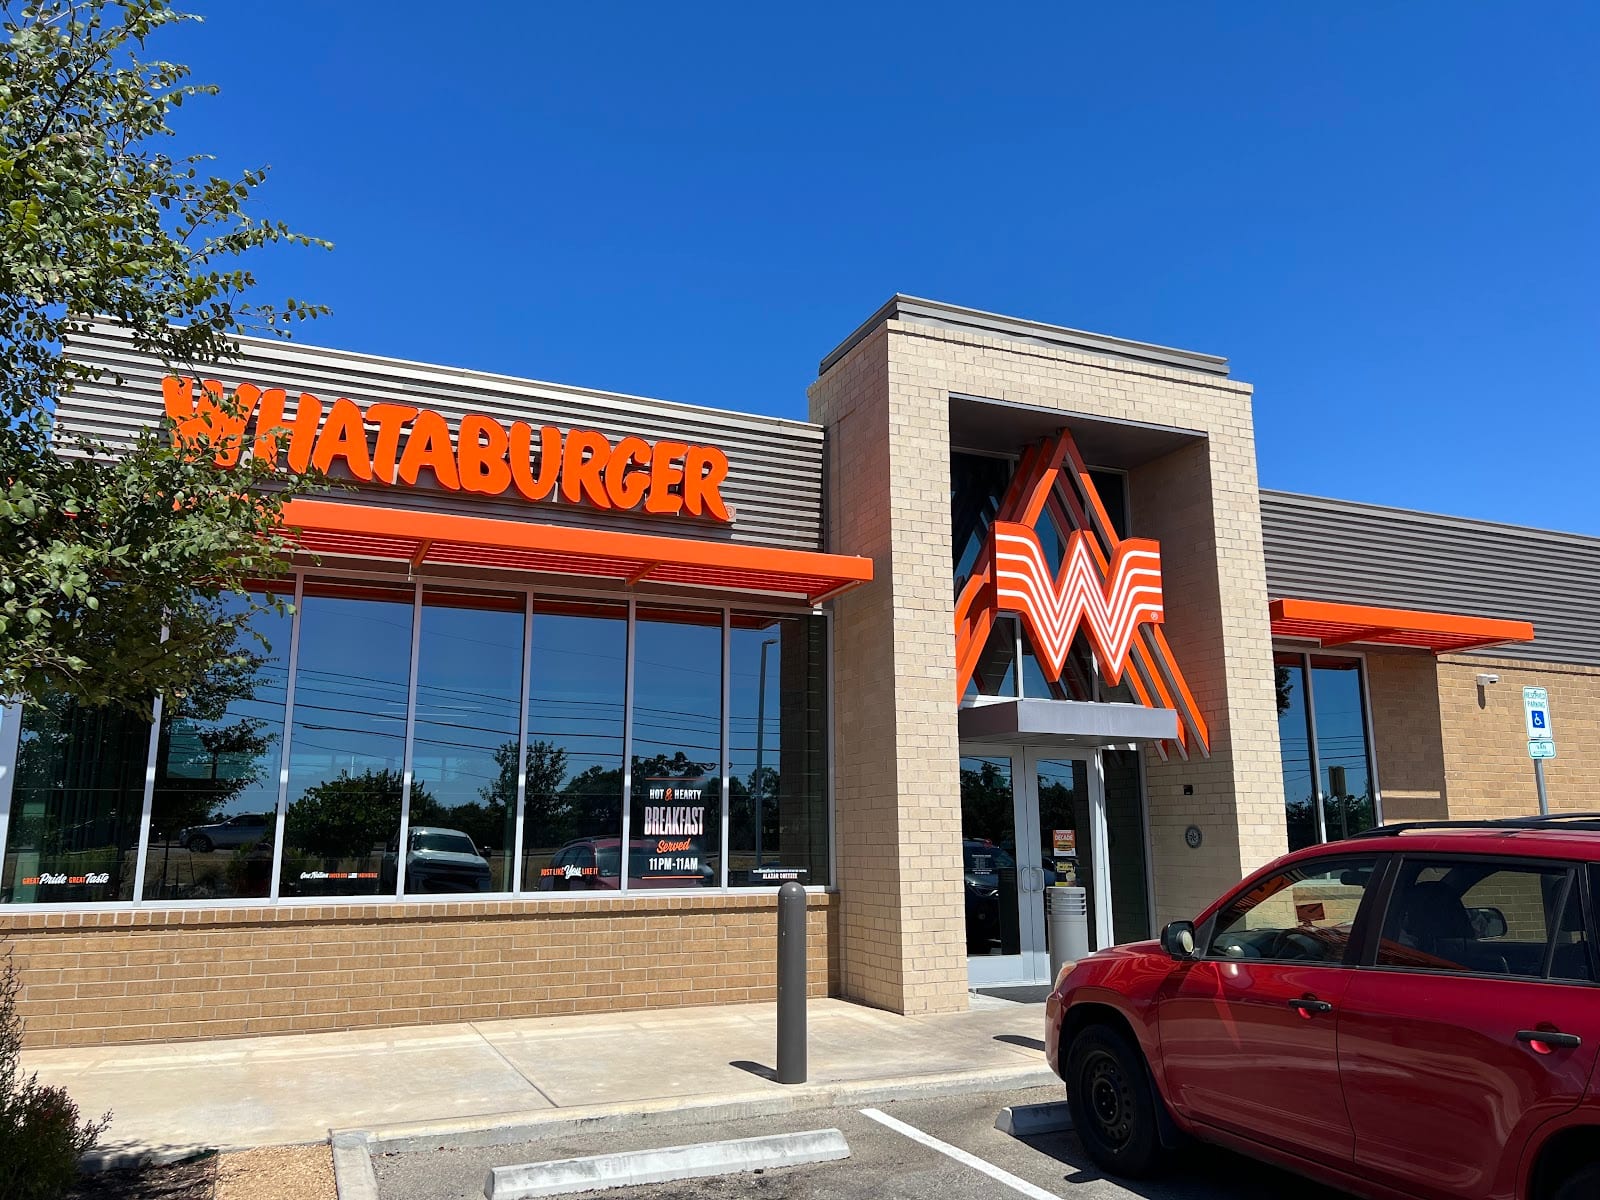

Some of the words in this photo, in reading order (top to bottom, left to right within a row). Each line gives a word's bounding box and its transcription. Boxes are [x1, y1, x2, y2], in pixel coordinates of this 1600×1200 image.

[161, 375, 730, 522] WHATABURGER
[649, 789, 664, 800] HOT
[665, 788, 673, 801] &
[674, 789, 702, 800] HEARTY
[644, 806, 705, 836] BREAKFAST
[656, 838, 691, 854] Served
[553, 868, 564, 876] LIKE
[562, 864, 582, 879] You
[649, 857, 698, 871] 11PM-11AM
[22, 877, 39, 885] GREAT
[39, 873, 67, 884] Pride
[68, 876, 85, 884] GREAT
[85, 873, 109, 884] Taste
